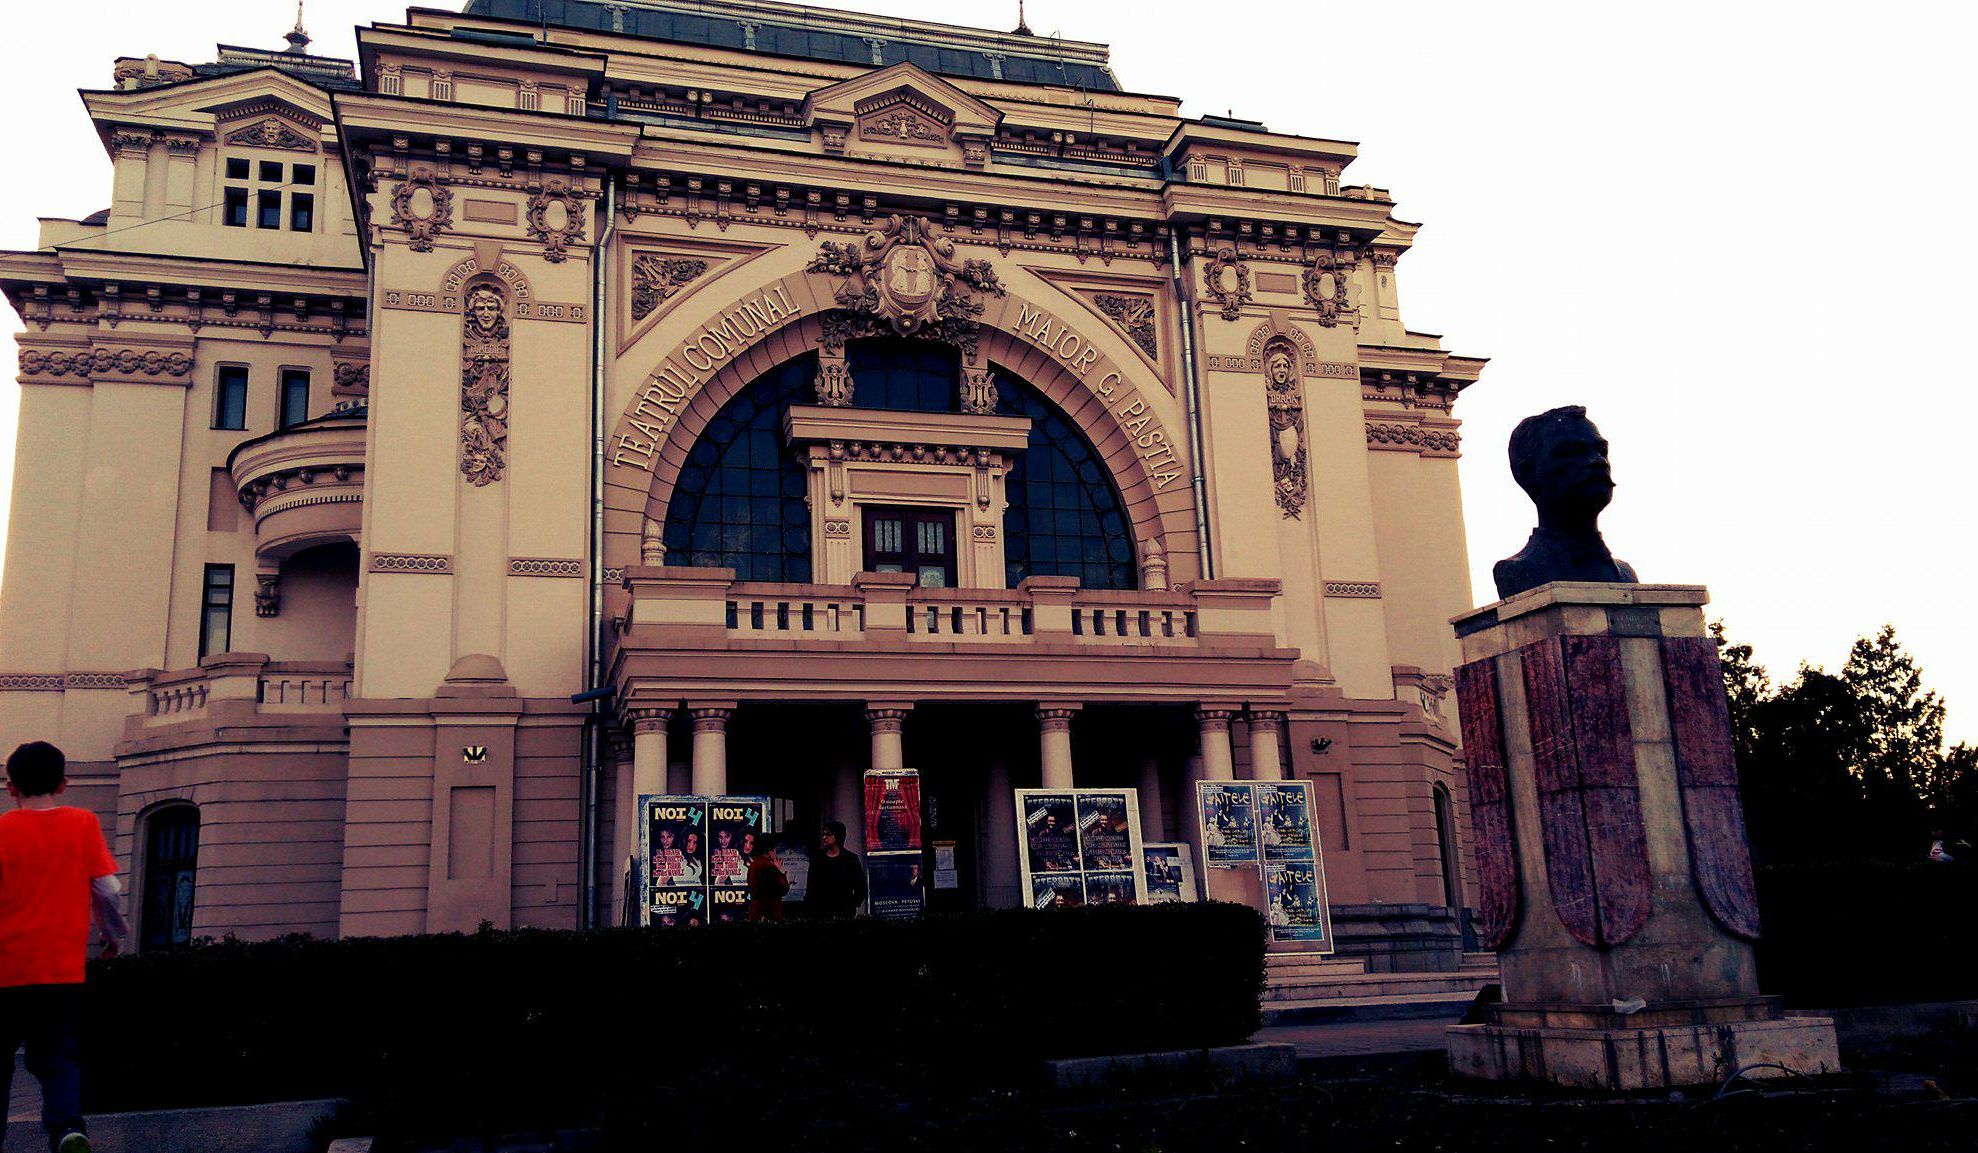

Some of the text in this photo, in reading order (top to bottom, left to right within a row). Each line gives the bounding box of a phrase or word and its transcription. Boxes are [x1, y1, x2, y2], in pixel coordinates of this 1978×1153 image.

[614, 287, 800, 470] TEATRUL COMUNAL
[1013, 304, 1183, 490] MAIOR G. PASTIA
[1271, 393, 1298, 404] DRAMA
[654, 806, 703, 827] NOI 4
[713, 807, 759, 827] NOI 4
[655, 891, 687, 905] NOI
[689, 890, 704, 911] 4
[714, 890, 746, 904] NOI
